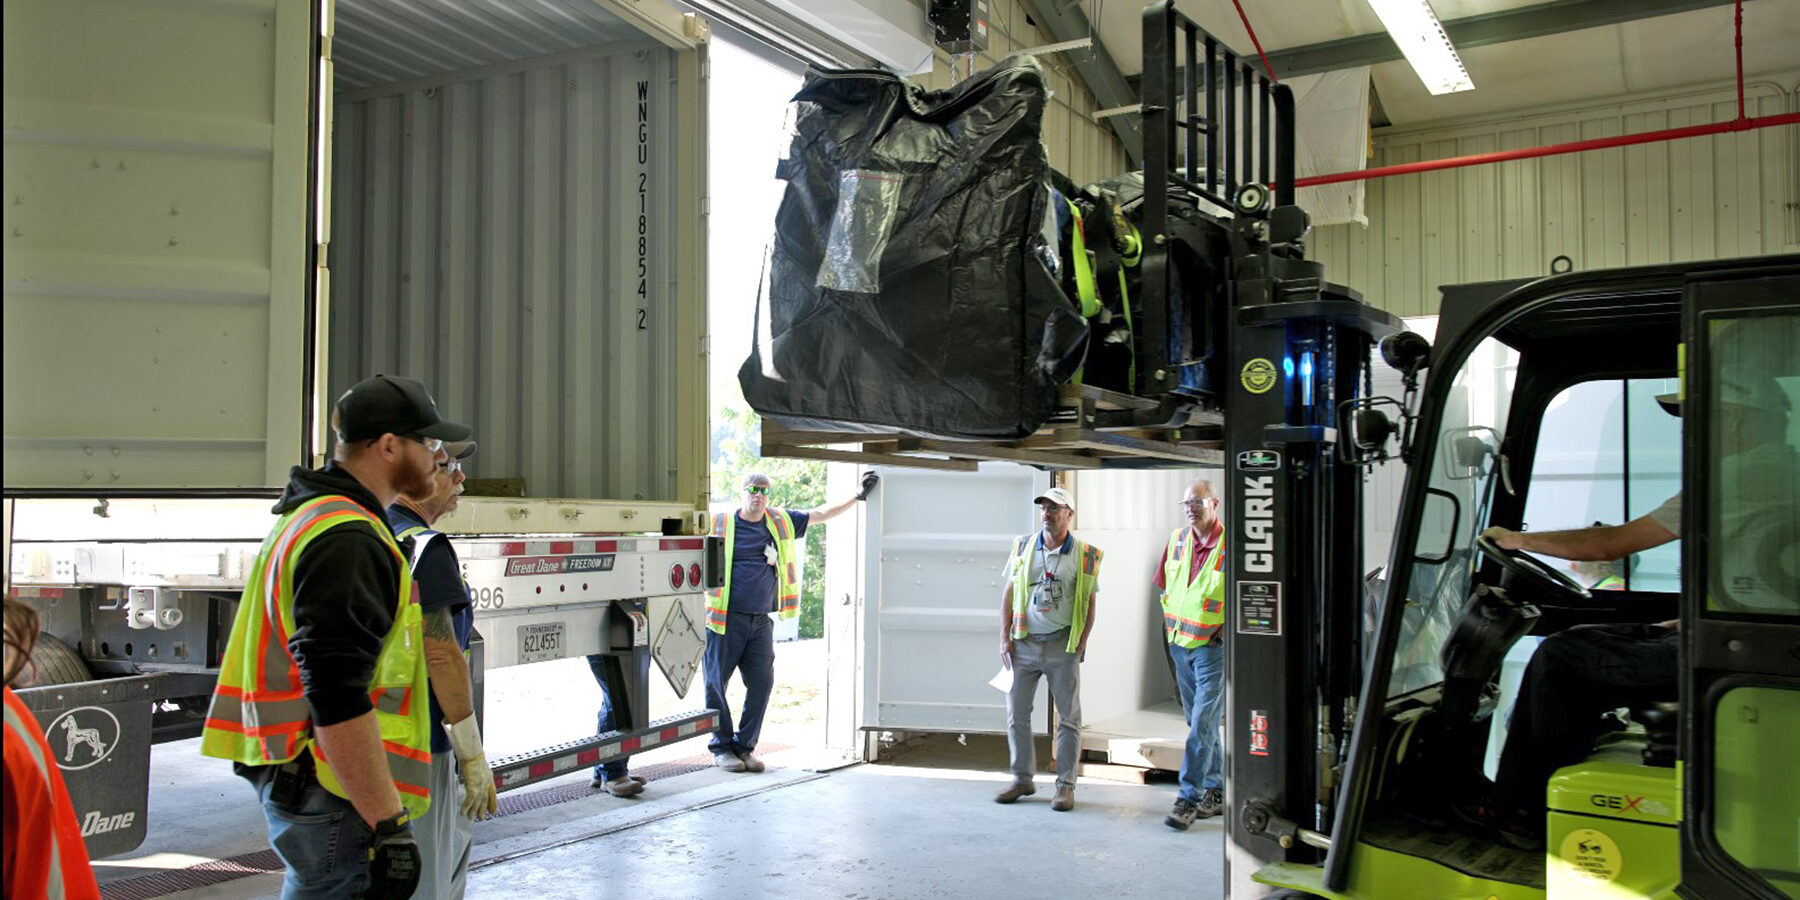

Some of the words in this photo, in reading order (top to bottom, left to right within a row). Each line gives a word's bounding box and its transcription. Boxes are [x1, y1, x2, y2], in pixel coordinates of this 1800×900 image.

[637, 81, 648, 165] WNGU
[638, 173, 647, 299] 218854
[637, 309, 647, 330] 2
[1244, 476, 1274, 573] CLARK
[510, 560, 536, 574] Great
[536, 558, 559, 573] Dane
[524, 632, 561, 653] 621455T
[81, 810, 135, 837] Dane
